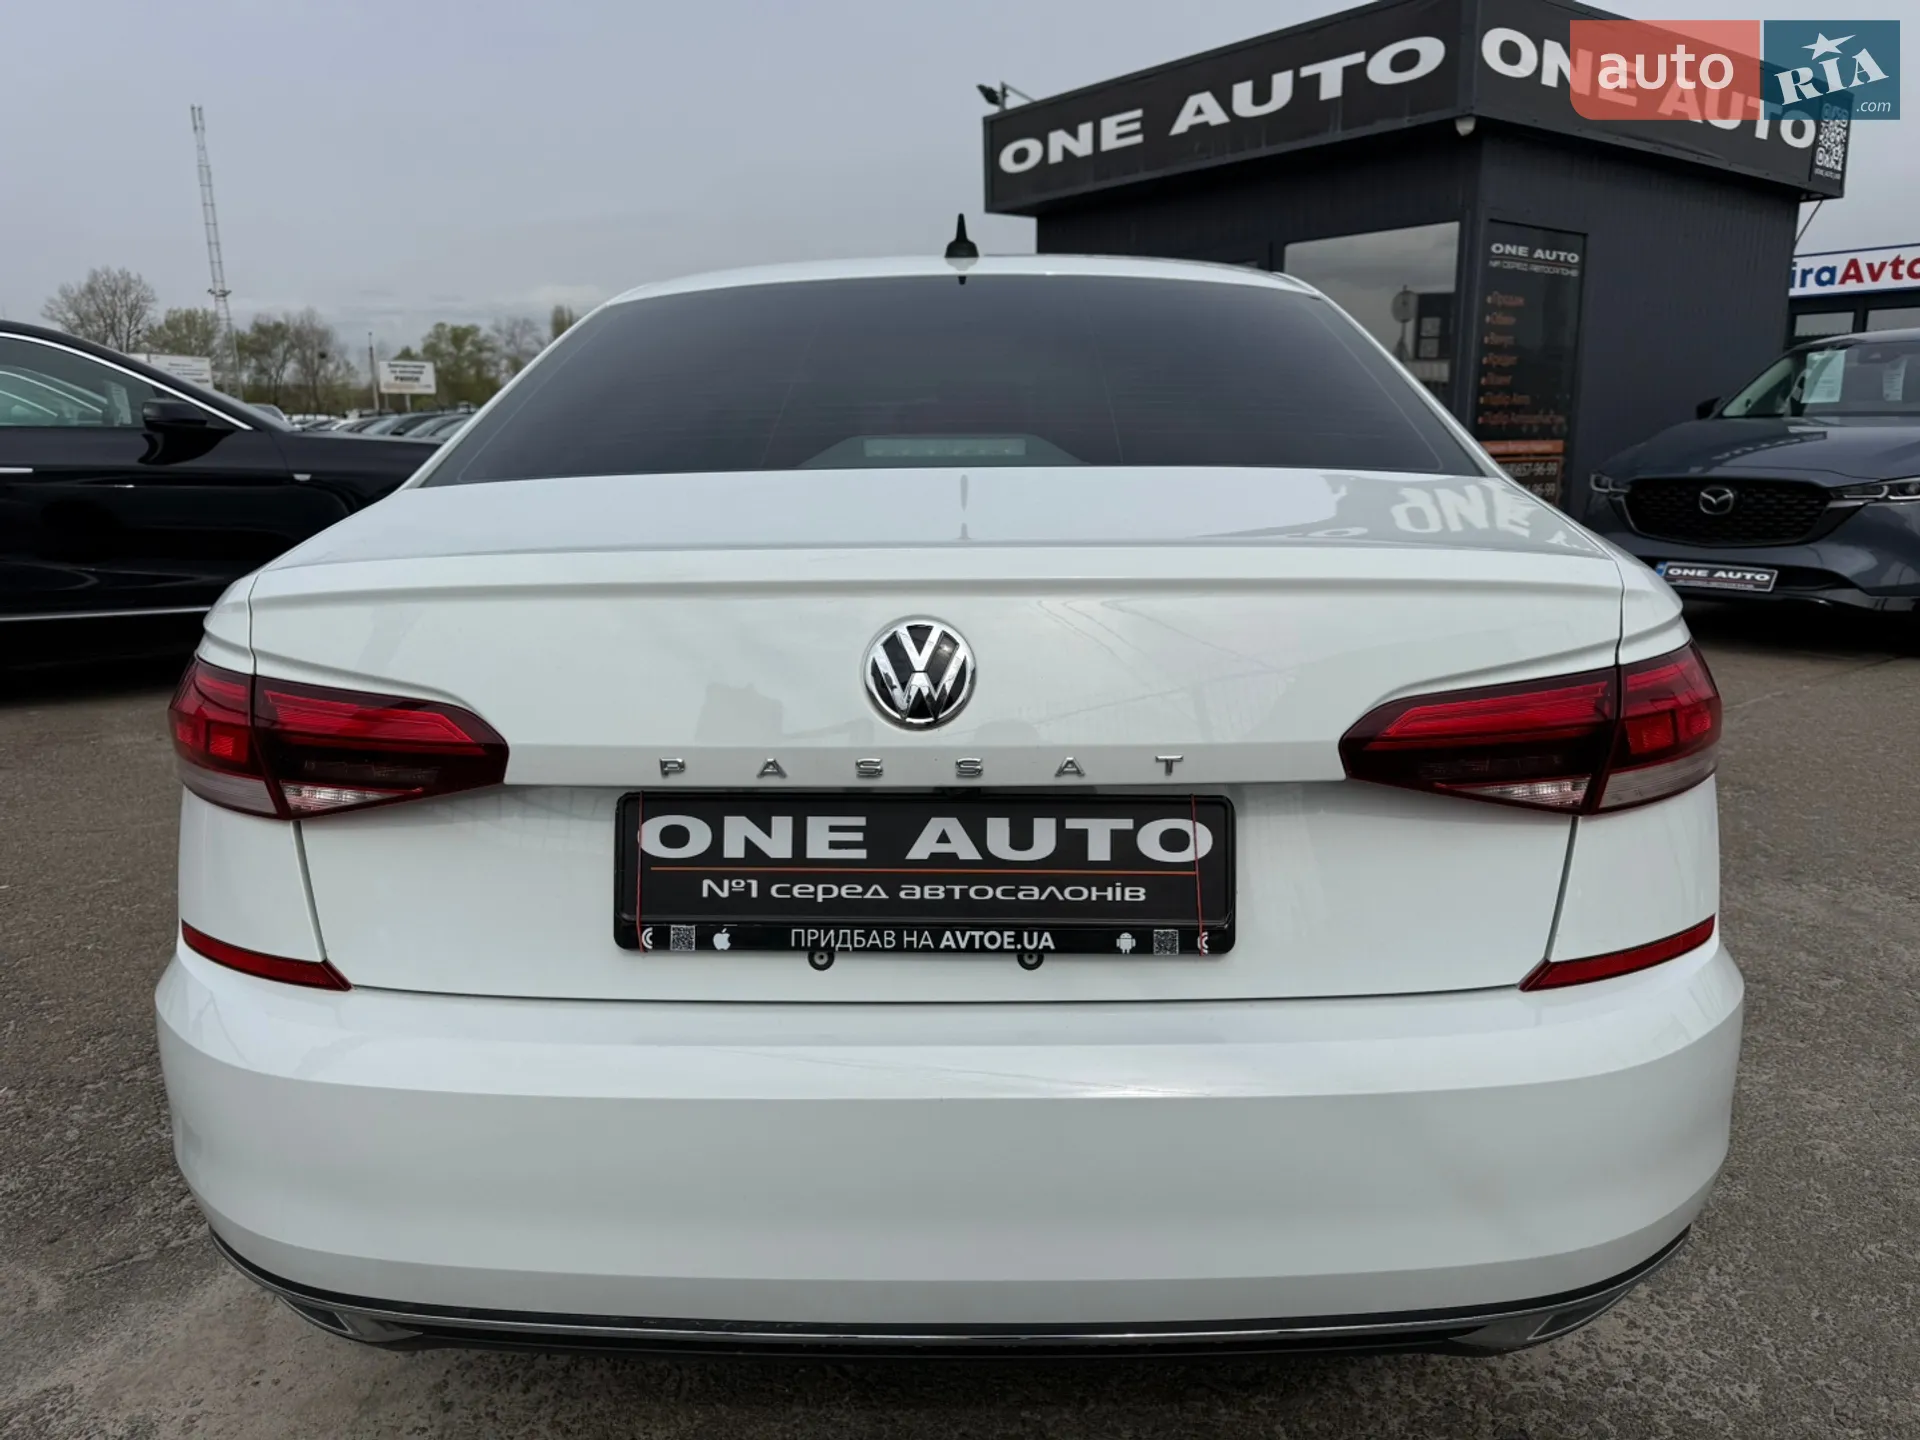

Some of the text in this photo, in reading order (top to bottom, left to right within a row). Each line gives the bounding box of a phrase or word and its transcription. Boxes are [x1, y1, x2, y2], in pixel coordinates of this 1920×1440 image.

[1481, 27, 1816, 149] ONE AUTO
[999, 36, 1445, 174] ONE AUTO
[1490, 243, 1580, 263] ONE AUTO
[1668, 568, 1770, 581] ONE AUTO
[659, 755, 1184, 779] PASSAT
[637, 814, 1214, 863] ONE AUTO
[770, 883, 890, 902] серед
[899, 882, 1147, 902] автосалонів
[790, 929, 1056, 951] ПРИДБАВ НА AVTOE.UA
